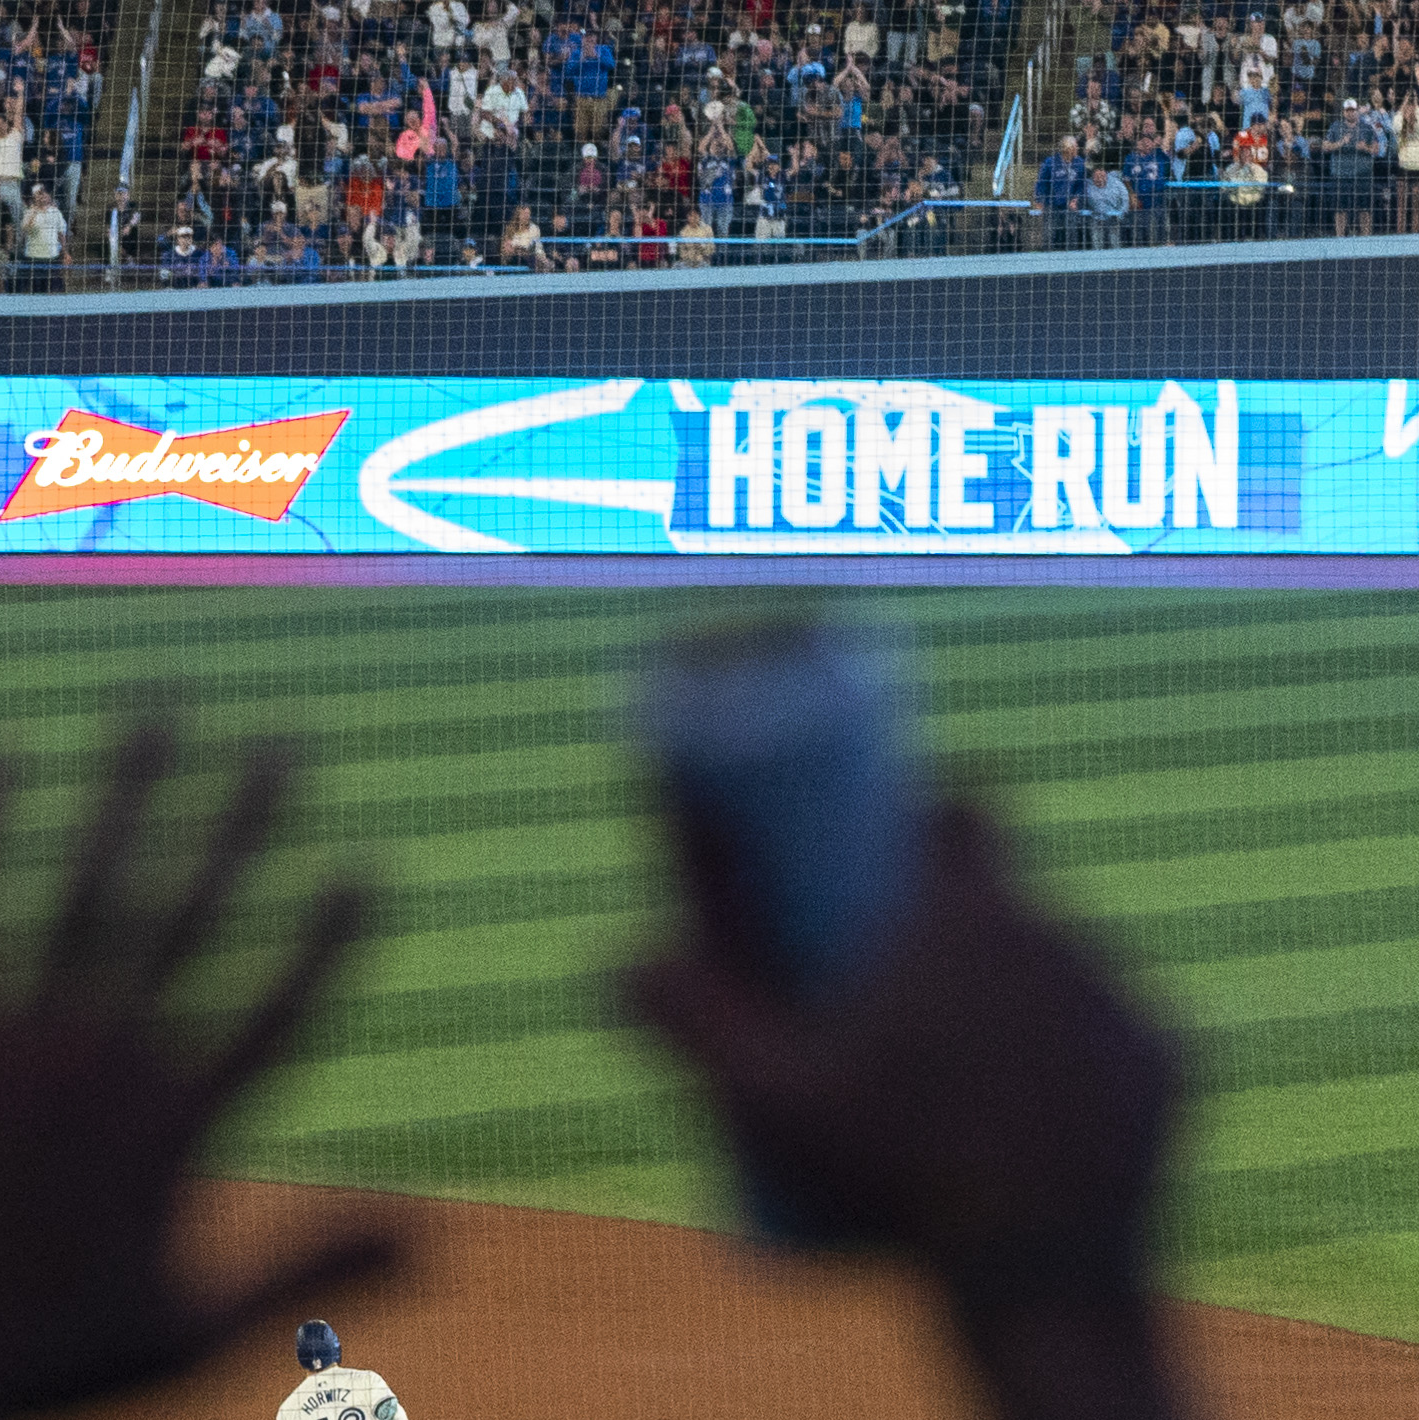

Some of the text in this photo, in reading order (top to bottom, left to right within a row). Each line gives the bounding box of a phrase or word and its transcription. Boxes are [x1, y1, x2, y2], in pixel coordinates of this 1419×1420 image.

[24, 428, 318, 488] Budweiser
[708, 398, 1240, 530] HOME RUN
[301, 1387, 352, 1416] HORWITZ
